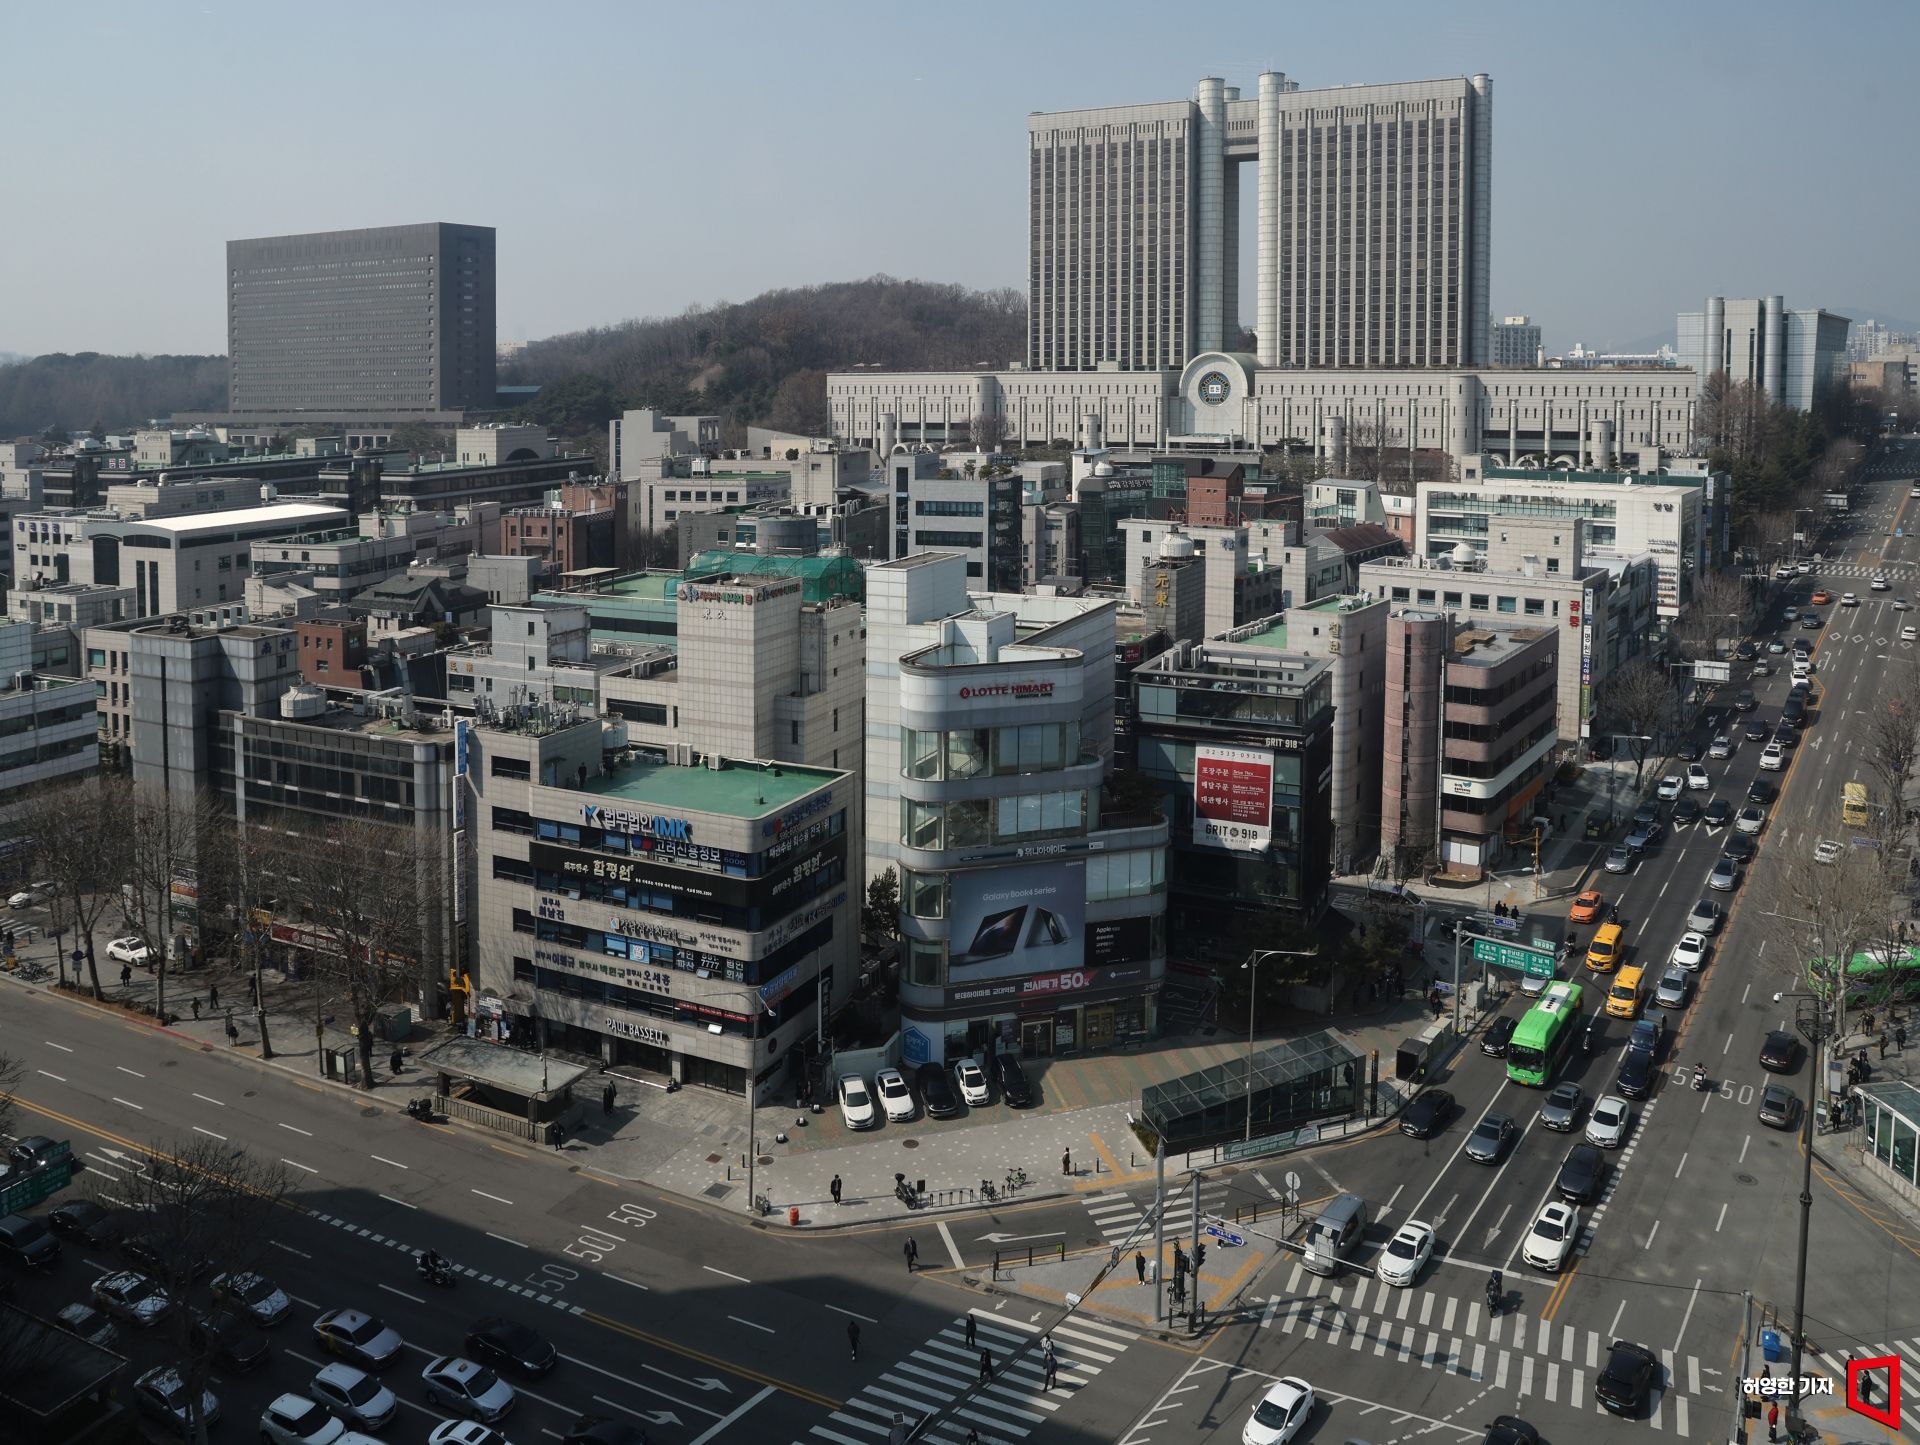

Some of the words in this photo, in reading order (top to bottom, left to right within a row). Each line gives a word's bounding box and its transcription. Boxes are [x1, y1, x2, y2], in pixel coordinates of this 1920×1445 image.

[972, 686, 1009, 697] LOTTE
[1011, 683, 1055, 695] HIMART
[1266, 737, 1284, 748] GRIT
[1285, 739, 1298, 749] 918
[1202, 766, 1229, 777] 포장주문
[1201, 781, 1229, 791] 배달주문
[604, 807, 652, 833] 법무법인
[654, 815, 689, 841] IMK
[1205, 823, 1229, 837] GRIT
[1241, 828, 1259, 839] 918
[654, 839, 721, 862] 고려신용정보
[1024, 844, 1067, 857] 위니아에이드
[593, 859, 634, 882] 함평원
[982, 891, 1010, 902] Galaxy
[1010, 888, 1034, 898] Book4
[1034, 885, 1057, 896] Series
[1096, 926, 1112, 934] Apple
[701, 959, 720, 970] 7777
[1532, 956, 1550, 965] 강남역
[606, 1017, 627, 1033] PAUL
[628, 1020, 664, 1042] BASSETT
[1720, 1079, 1754, 1105] 50
[606, 1203, 657, 1228] 50
[563, 1235, 616, 1262] 50
[525, 1264, 579, 1292] 50
